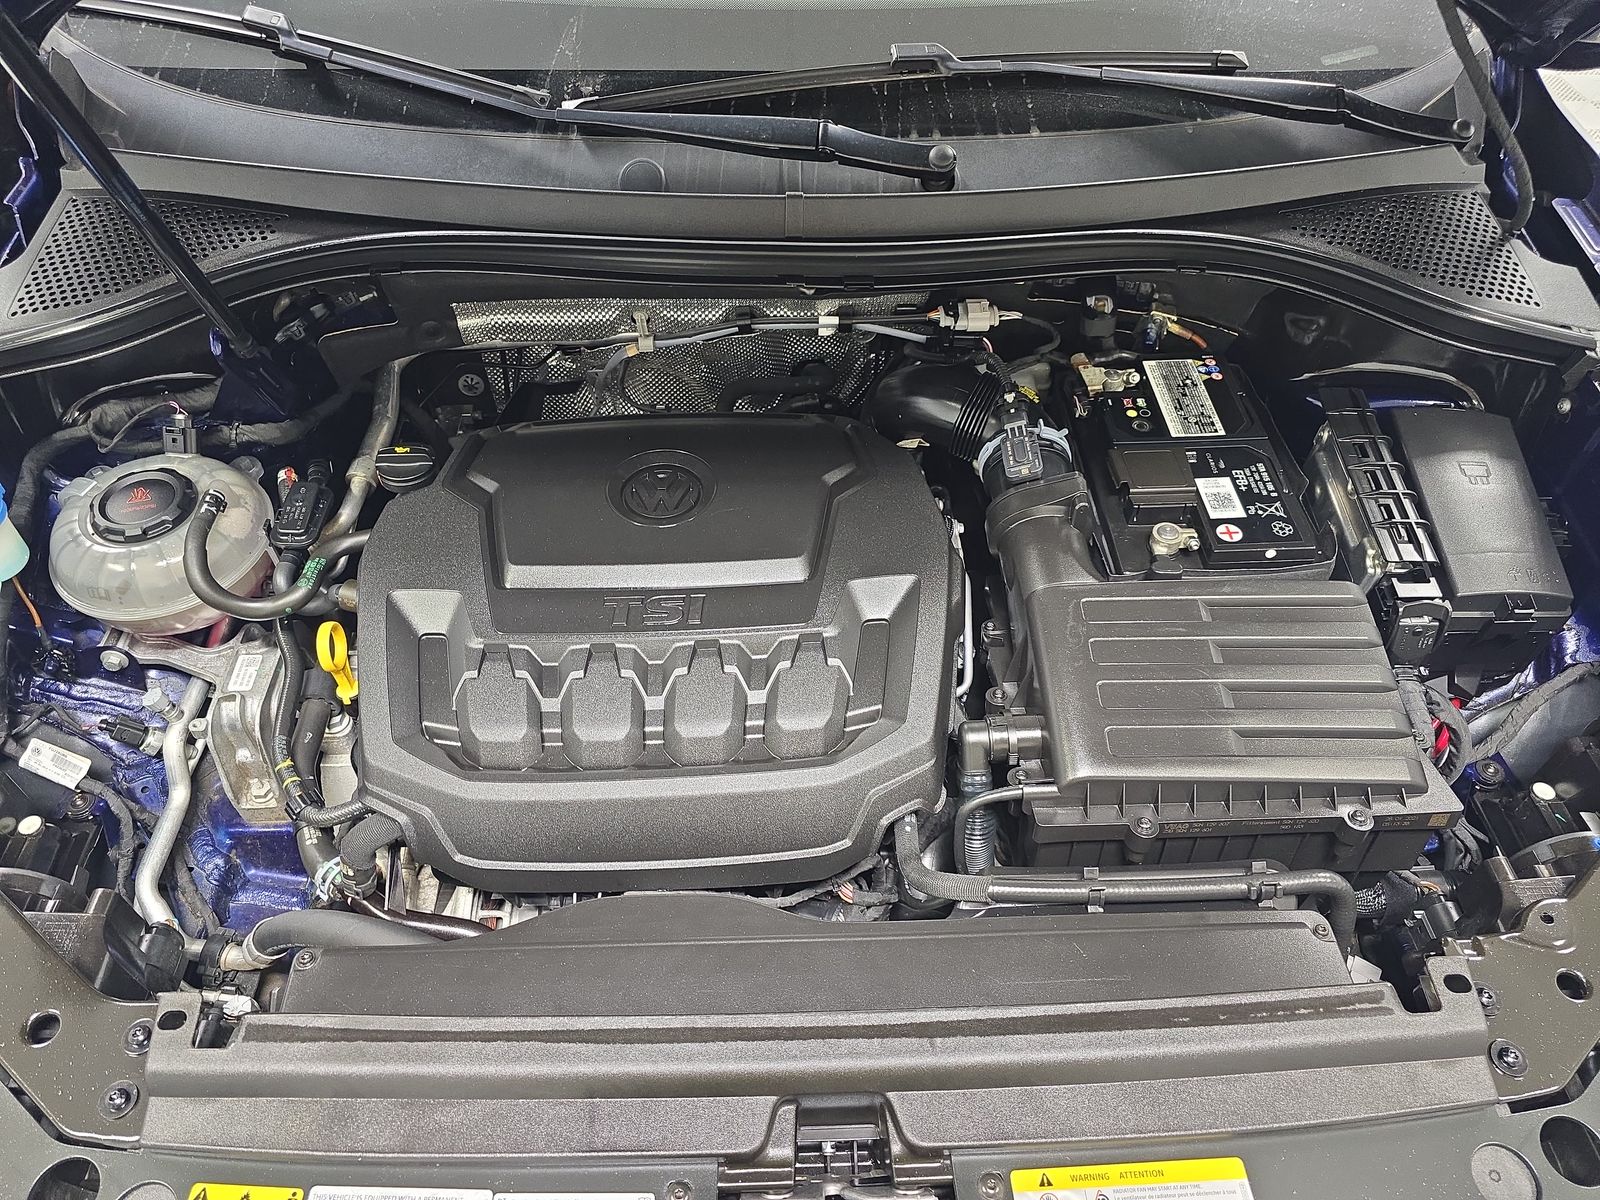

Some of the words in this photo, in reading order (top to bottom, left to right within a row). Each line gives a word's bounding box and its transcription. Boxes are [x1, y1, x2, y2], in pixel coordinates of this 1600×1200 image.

[1206, 453, 1218, 474] CLARIOS
[1232, 470, 1248, 491] EFB+
[1246, 505, 1256, 515] Pb
[603, 593, 707, 628] TSI
[1070, 1172, 1110, 1182] WARNING
[1119, 1169, 1164, 1179] ATTENTION
